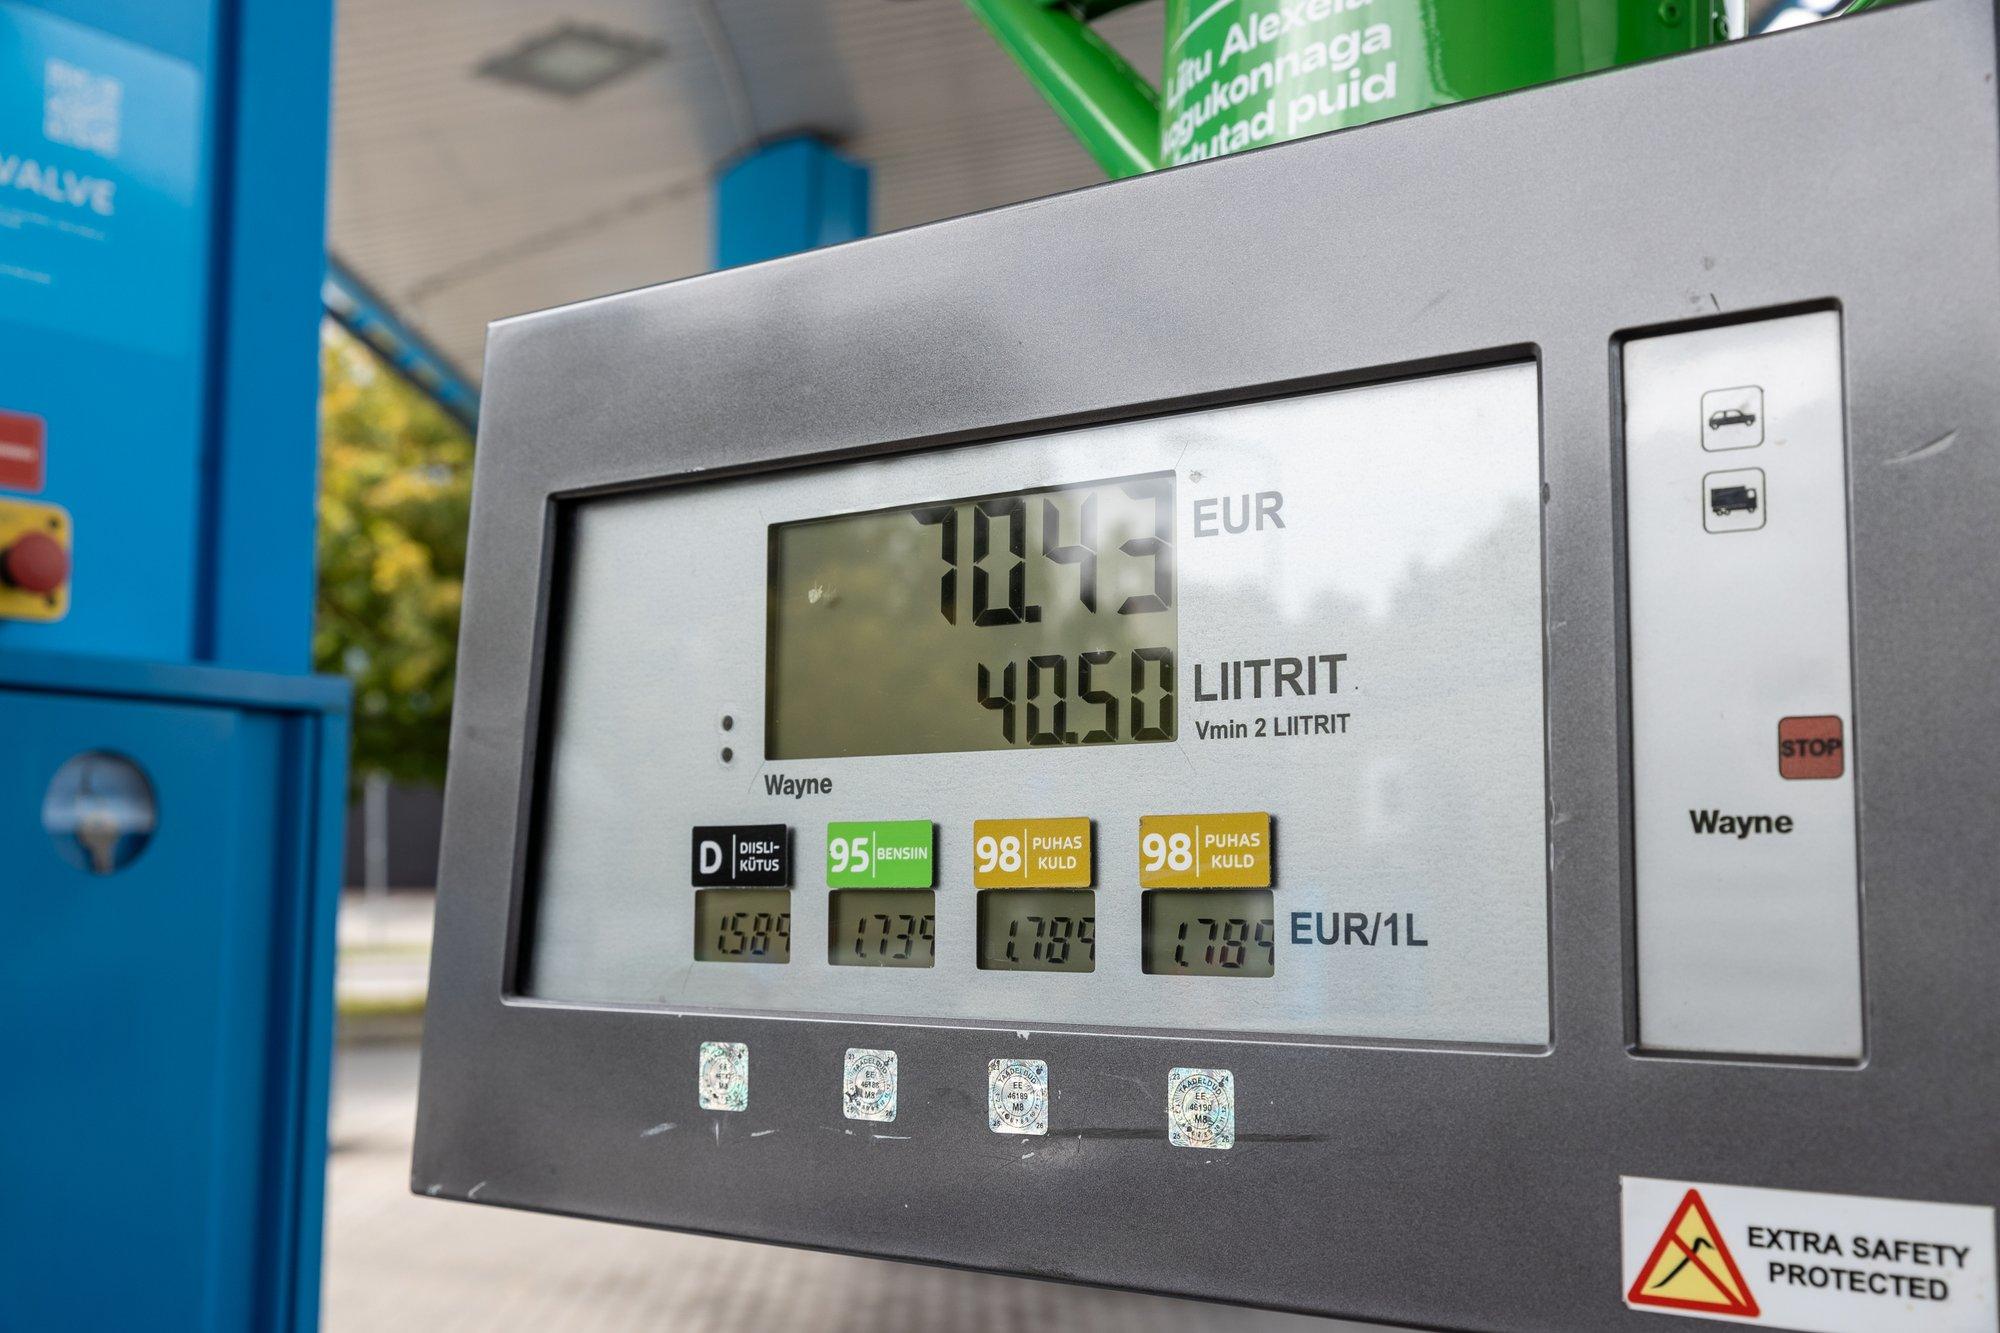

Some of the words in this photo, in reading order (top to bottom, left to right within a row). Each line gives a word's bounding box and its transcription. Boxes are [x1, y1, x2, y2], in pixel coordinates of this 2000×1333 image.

[1218, 0, 1371, 68] Alexe
[1287, 61, 1397, 136] puid
[1194, 490, 1286, 538] EUR
[911, 484, 1175, 627] 70.43
[1194, 653, 1348, 702] LIITRIT
[977, 646, 1174, 746] 40.50
[1195, 719, 1248, 740] Vmin
[1254, 717, 1267, 737] 2
[1274, 713, 1351, 737] LIITRIT
[1780, 738, 1843, 758] STOP
[764, 774, 833, 799] Wayne
[1205, 832, 1261, 848] PUHAS
[1689, 810, 1794, 840] Wayne
[700, 840, 723, 875] D
[739, 841, 780, 855] DIISLI-
[829, 837, 870, 873] 95
[876, 846, 928, 860] BENSIIN
[976, 836, 1022, 873] 98
[1032, 836, 1082, 850] PUHAS
[1142, 832, 1193, 872] 98
[739, 857, 780, 872] KÜTUS
[1038, 856, 1077, 870] KULD
[1211, 854, 1255, 869] KULD
[1290, 911, 1429, 947] EUR/1L
[1013, 1081, 1023, 1089] EE
[1748, 1226, 1843, 1256] EXTRA
[1852, 1236, 1971, 1269] SAFETY
[1768, 1262, 1949, 1302] PROTECTED
